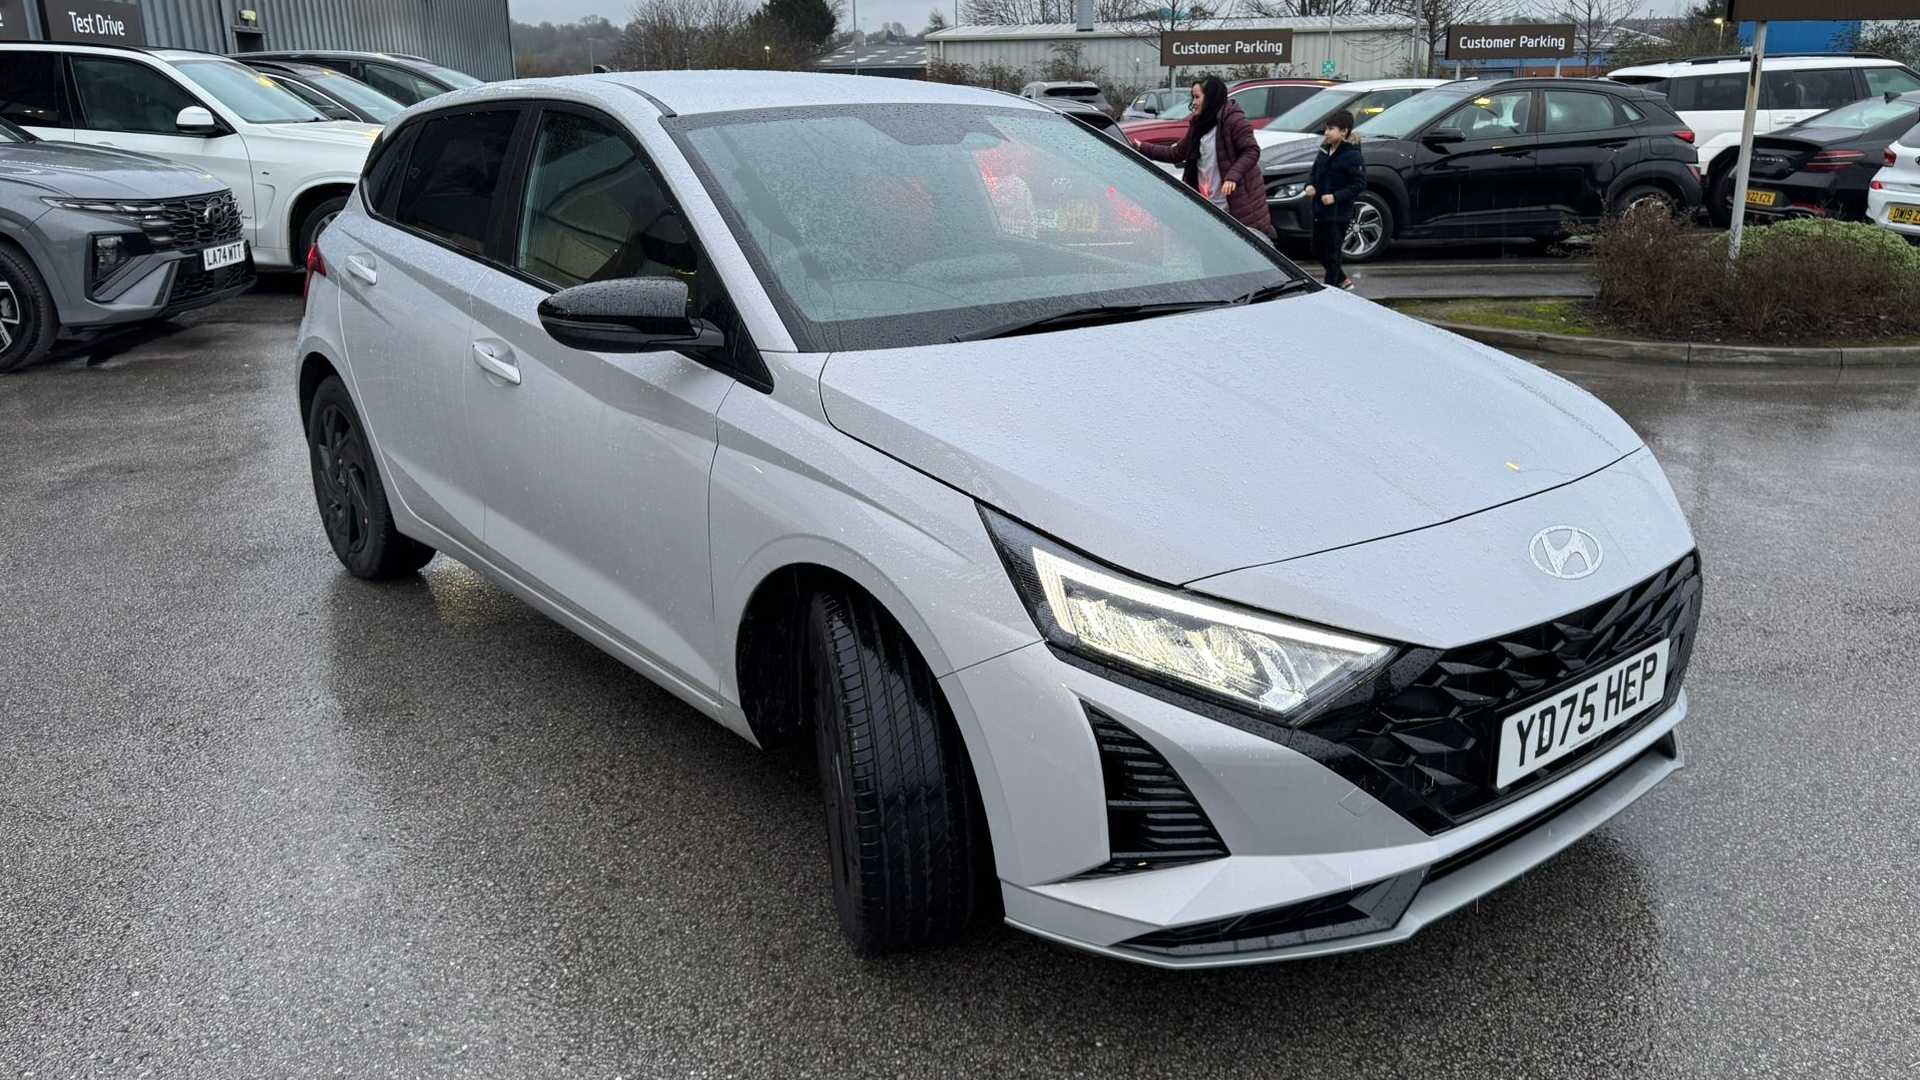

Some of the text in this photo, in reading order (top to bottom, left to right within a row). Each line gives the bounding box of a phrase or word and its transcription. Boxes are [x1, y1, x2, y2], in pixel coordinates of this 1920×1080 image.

[68, 11, 125, 36] Test Drive
[1172, 40, 1283, 55] Customer Parking
[1459, 35, 1566, 50] Customer Parking
[1516, 652, 1658, 767] YD75 HEP
